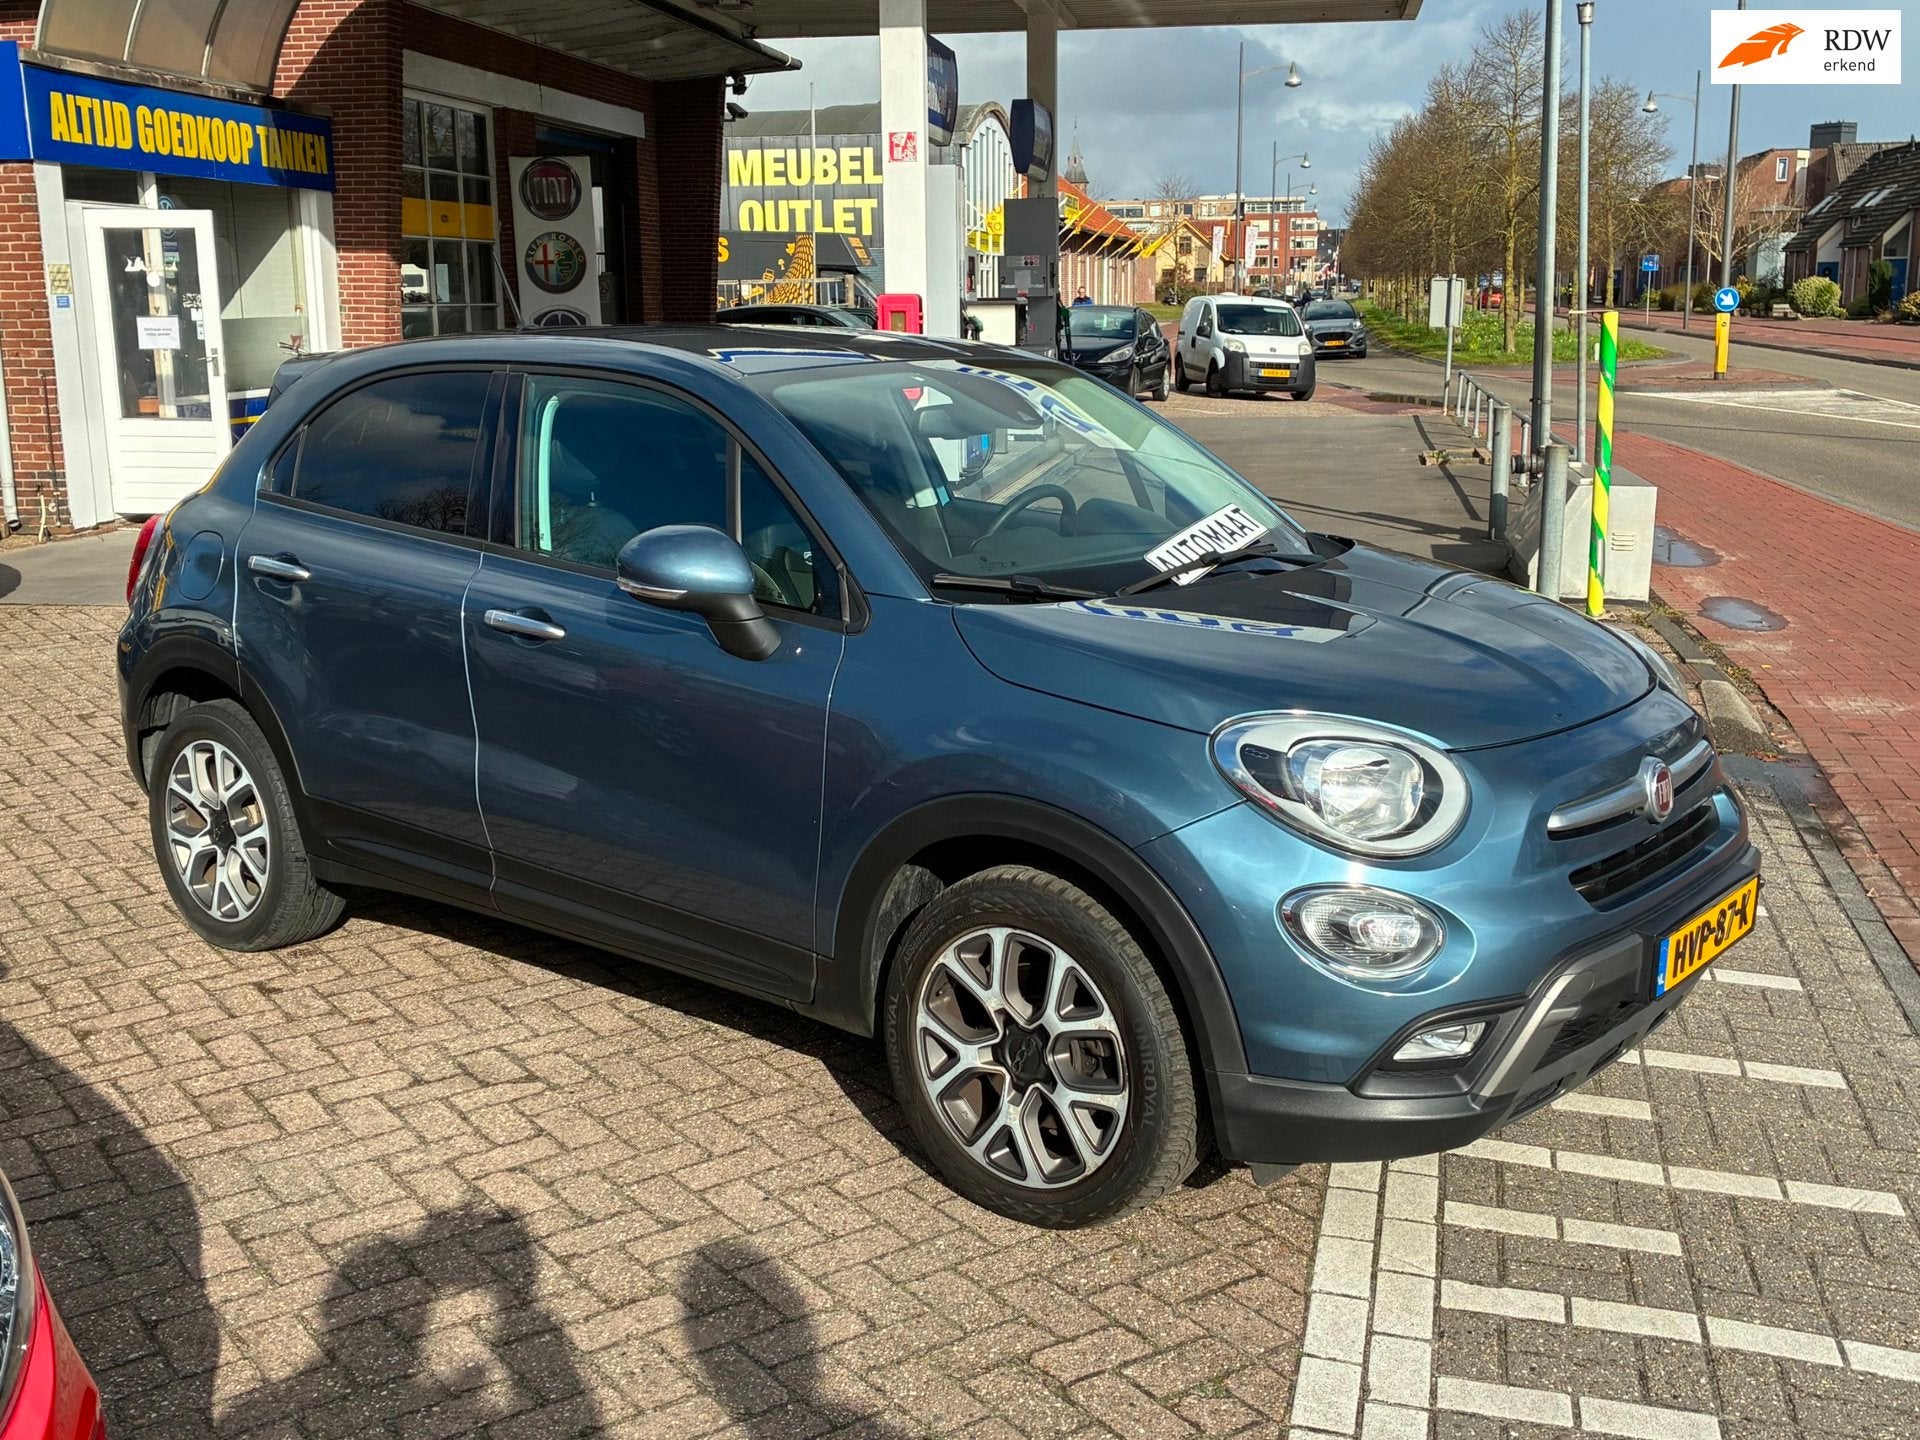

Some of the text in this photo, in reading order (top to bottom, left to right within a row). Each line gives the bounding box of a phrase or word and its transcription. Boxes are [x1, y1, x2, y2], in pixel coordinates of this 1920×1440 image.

[50, 90, 329, 175] ALTIJD GOEDKOOP TANKEN
[533, 176, 568, 205] FIAT
[728, 146, 883, 188] MEUBEL
[738, 198, 878, 236] OUTLET
[526, 232, 585, 265] ALFA ROMEO
[1156, 507, 1260, 581] AUTOMAAT
[1672, 889, 1752, 979] HVP-87-K
[1132, 1019, 1159, 1130] UNIROYAL
